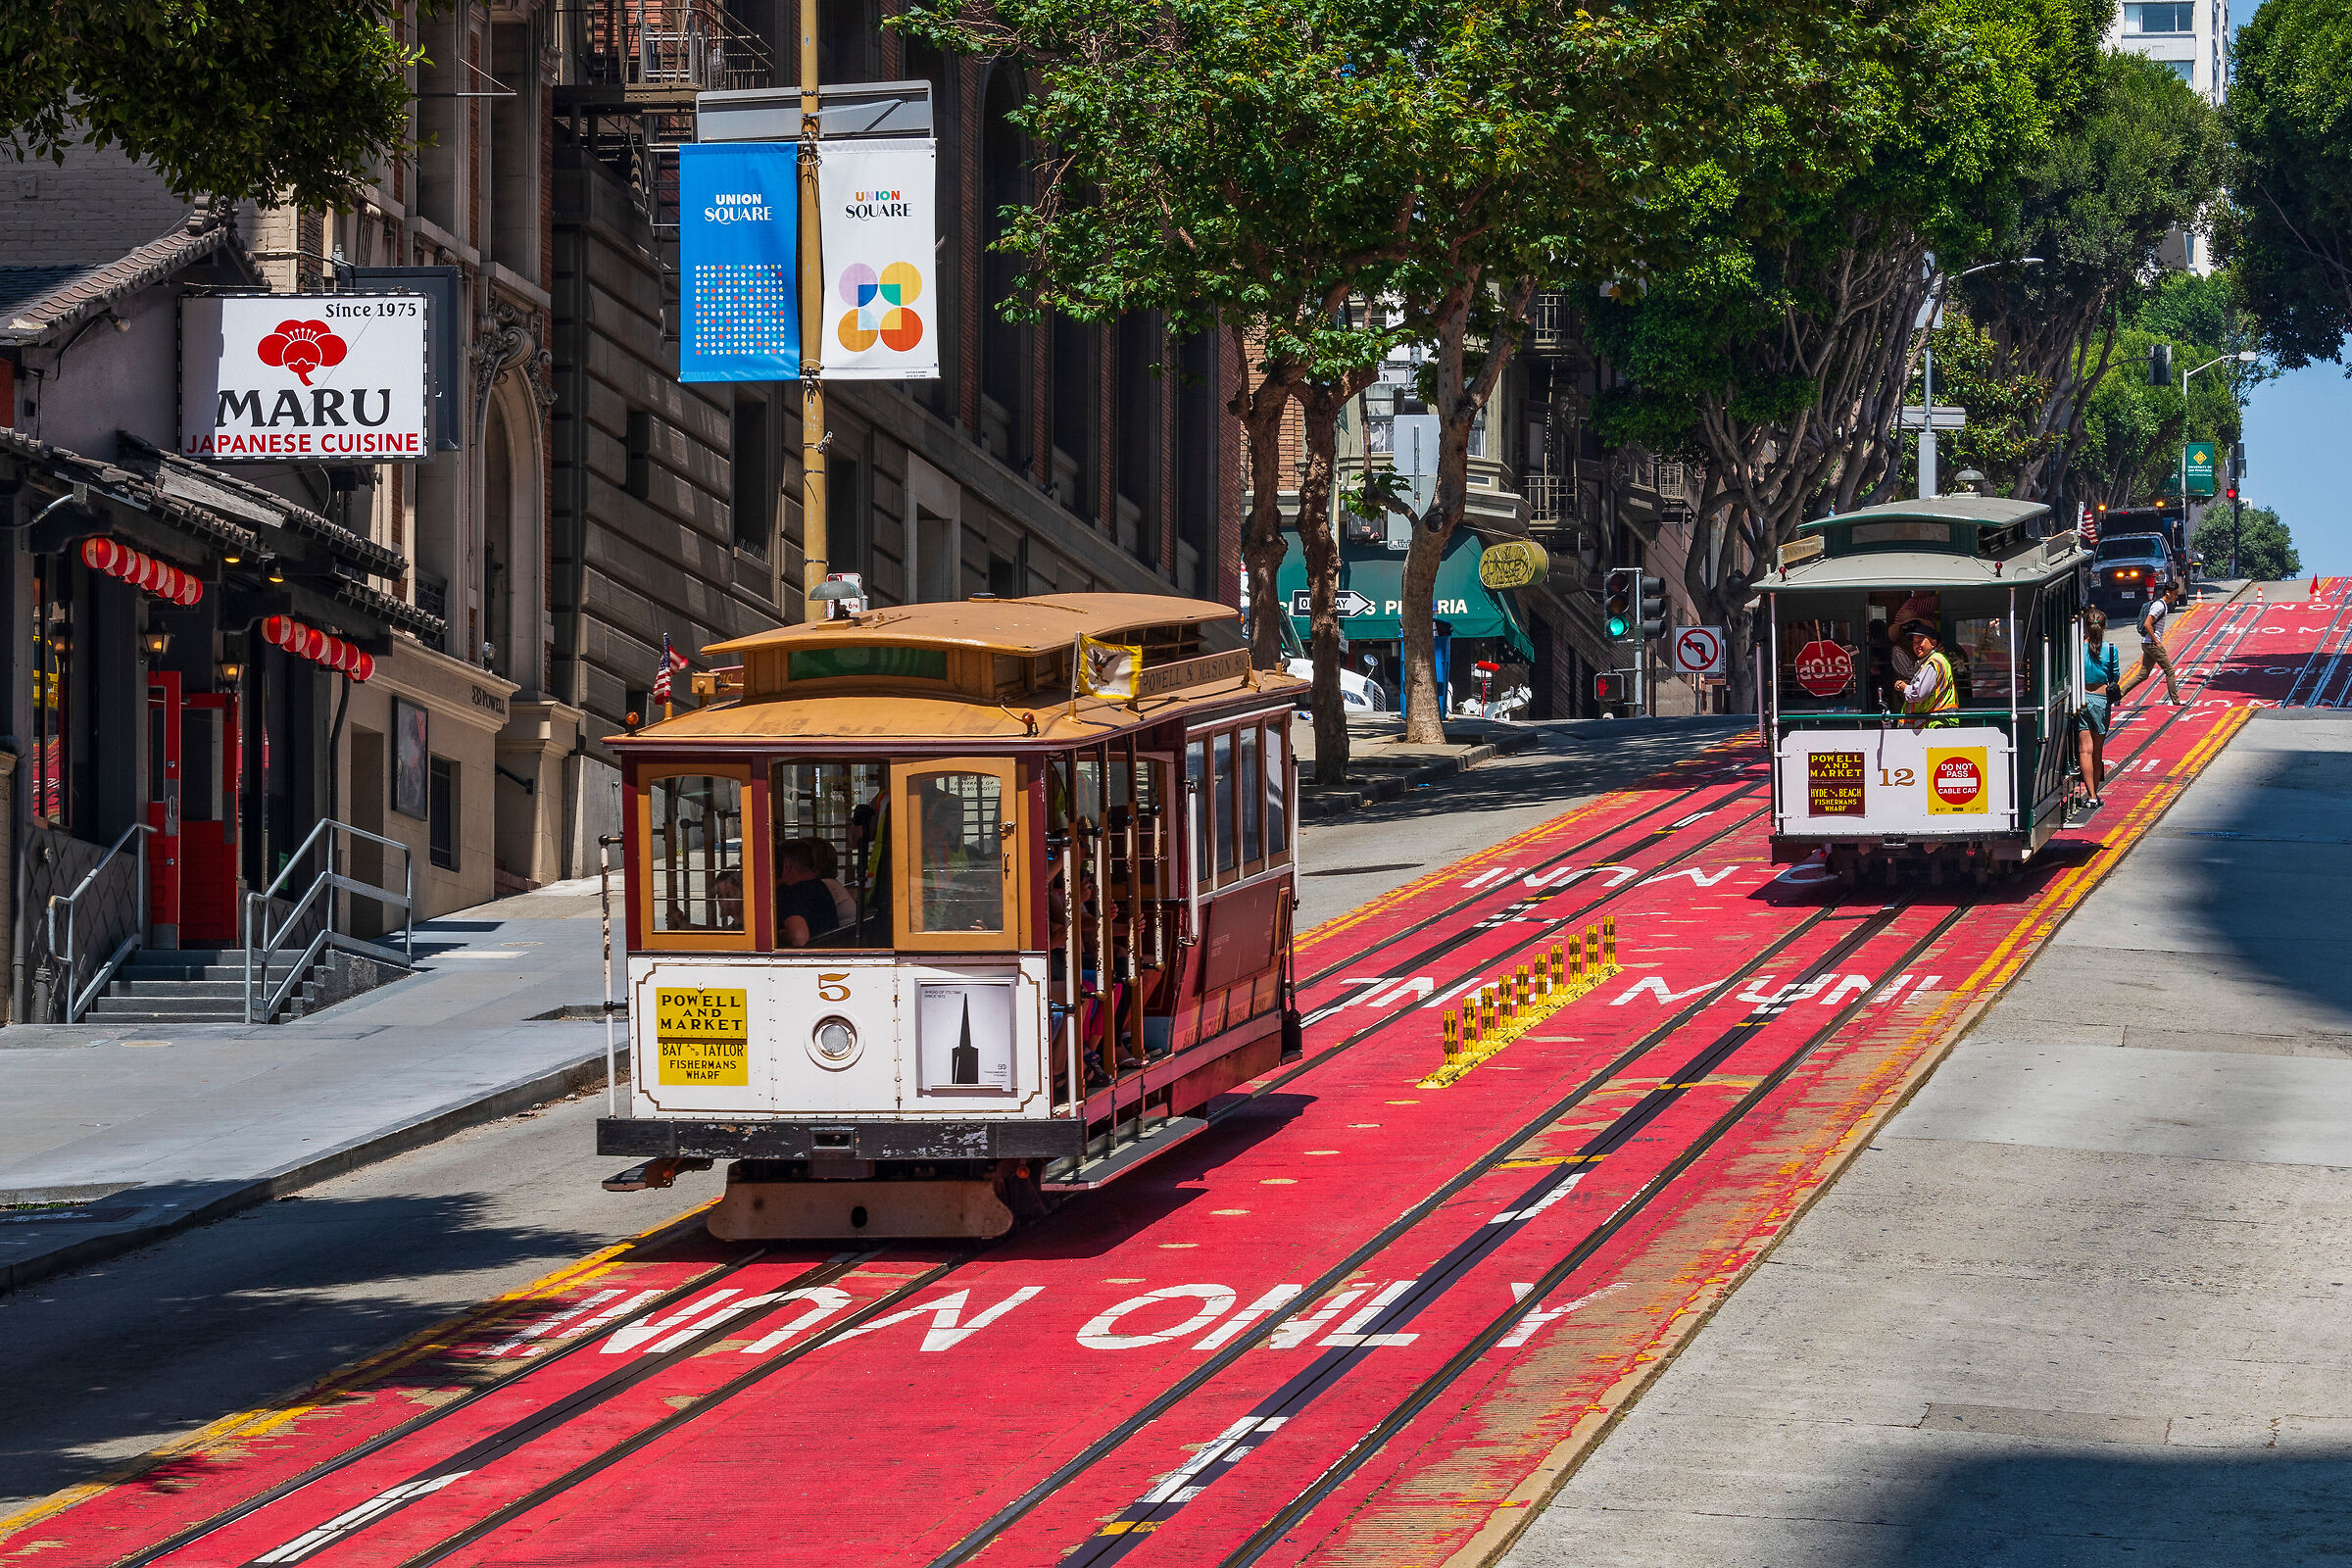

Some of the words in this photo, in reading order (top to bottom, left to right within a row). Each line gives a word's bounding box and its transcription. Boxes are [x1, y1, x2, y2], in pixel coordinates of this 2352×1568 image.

[715, 193, 761, 206] UNION
[856, 190, 901, 202] UNION
[704, 206, 773, 225] SQUARE
[845, 202, 912, 221] SQUARE
[325, 303, 371, 318] Since
[376, 303, 416, 318] 1975
[215, 388, 391, 428] MARU
[186, 434, 312, 454] JAPANESE
[320, 433, 418, 453] CUISINE
[1336, 599, 1348, 609] AY
[1385, 599, 1468, 615] PIRIA
[1199, 657, 1232, 681] MASON
[1799, 655, 1848, 680] STOP
[482, 689, 506, 715] POWELL
[1810, 754, 1862, 763] POWELL
[1810, 768, 1862, 777] MARKET
[1879, 767, 1916, 787] 12
[1810, 788, 1829, 798] HYDE
[1838, 788, 1862, 798] BEACH
[818, 972, 852, 1002] 5
[1339, 976, 1556, 1009] ONL
[662, 995, 741, 1007] POWELL
[682, 1008, 721, 1018] AND
[660, 1018, 743, 1031] MARKET
[662, 1043, 682, 1056] BAY
[702, 1043, 744, 1057] TAYLOR
[669, 1059, 737, 1069] FISHERMANS
[686, 1070, 720, 1080] WHARF
[478, 1286, 1046, 1356] MUNI
[1076, 1281, 1632, 1350] ONLY
